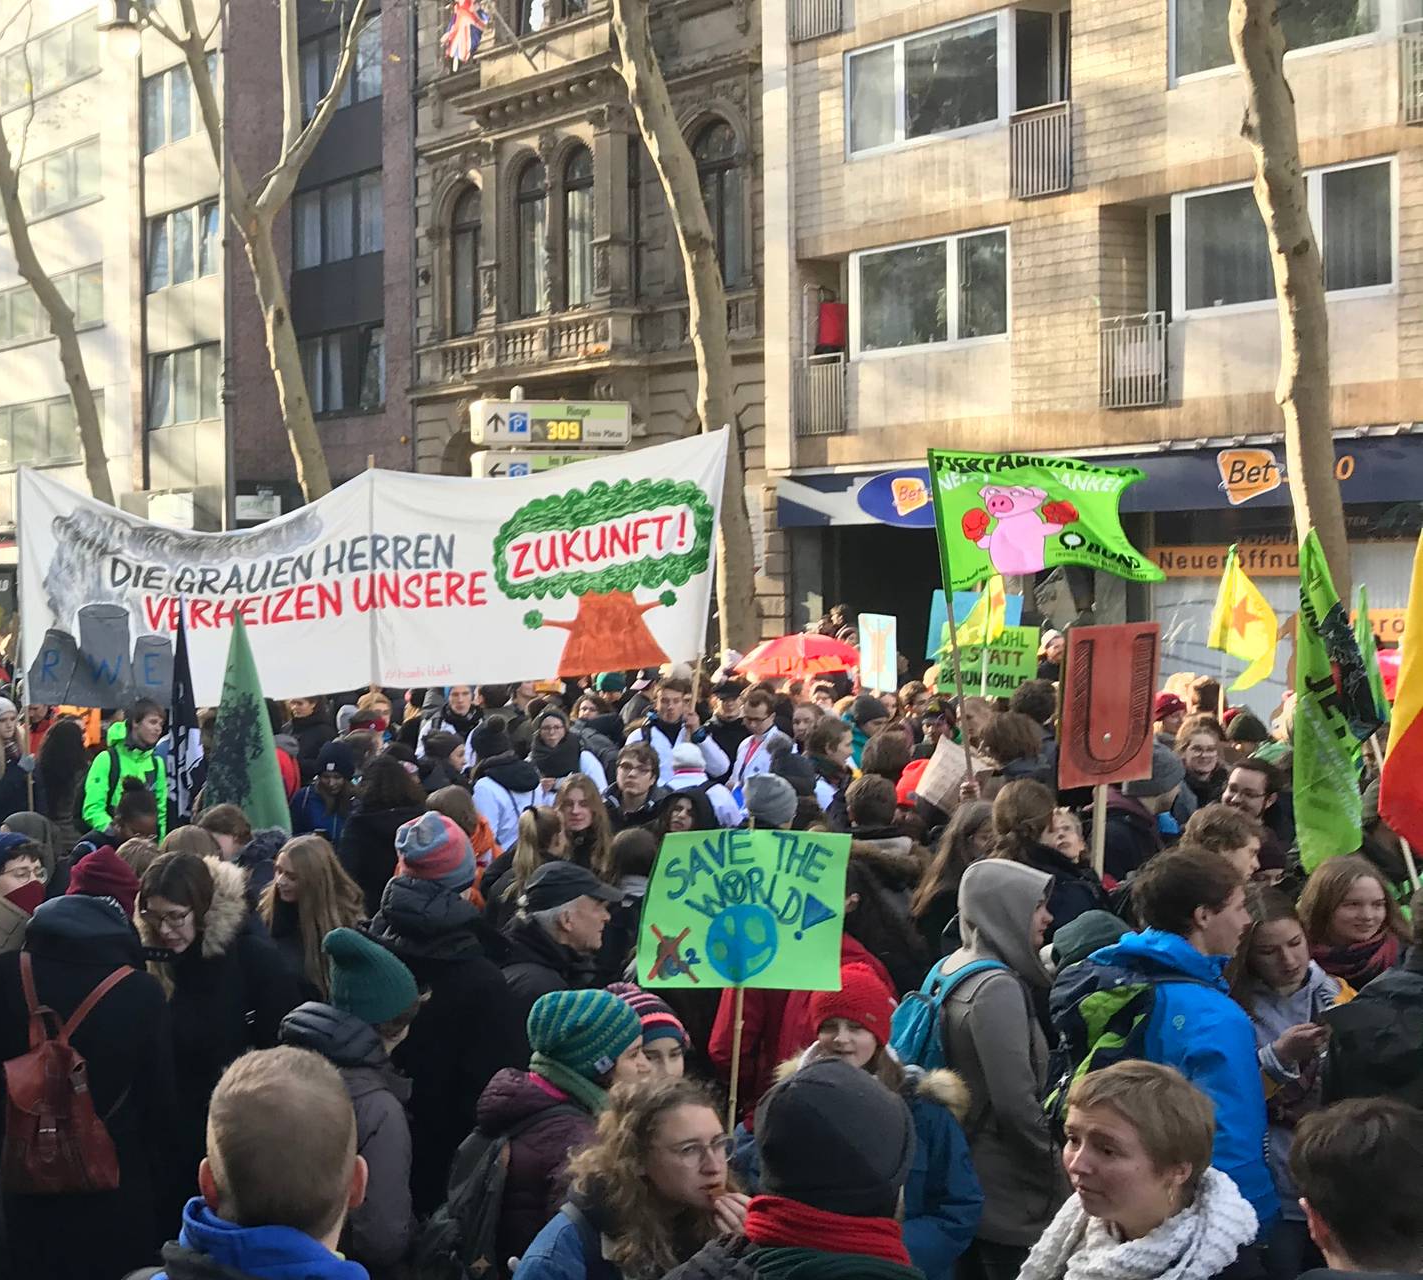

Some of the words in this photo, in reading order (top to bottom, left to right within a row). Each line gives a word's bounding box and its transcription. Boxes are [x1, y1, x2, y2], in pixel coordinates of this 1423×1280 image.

[546, 421, 580, 441] 309
[898, 486, 922, 501] Bet
[1228, 459, 1275, 484] Bet
[111, 556, 167, 590] DIE
[175, 548, 314, 595] GRAUEN
[321, 533, 455, 577] HERREN
[510, 511, 687, 579] ZUKUNFT!
[144, 580, 342, 632] VERHEIZEN
[354, 570, 488, 613] UNSERE
[968, 645, 1024, 667] STATT
[1069, 632, 1158, 776] U
[664, 829, 756, 900] SAVE
[772, 831, 834, 883] THE
